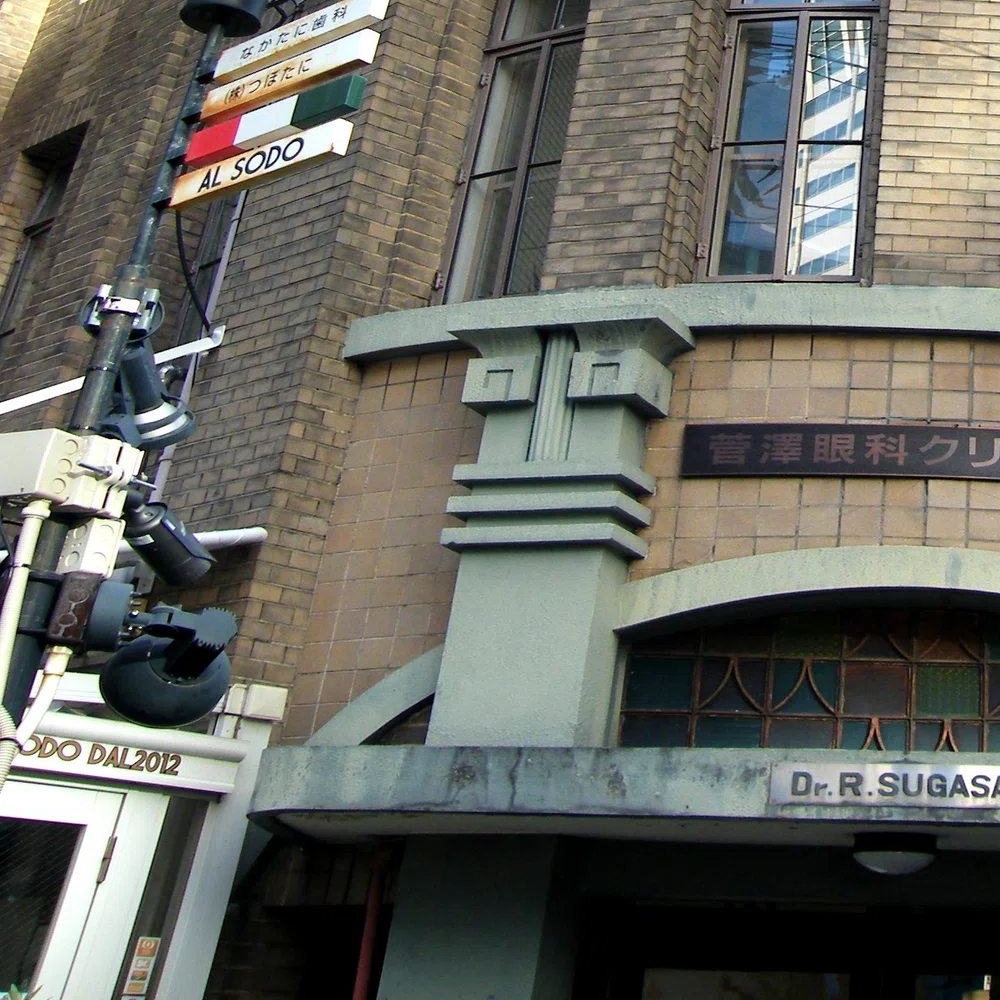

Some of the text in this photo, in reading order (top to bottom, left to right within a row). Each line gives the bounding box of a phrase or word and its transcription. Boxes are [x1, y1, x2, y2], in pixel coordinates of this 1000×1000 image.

[240, 5, 348, 59] なかたに歯科
[197, 137, 304, 193] AL SODO
[18, 735, 82, 761] ODO
